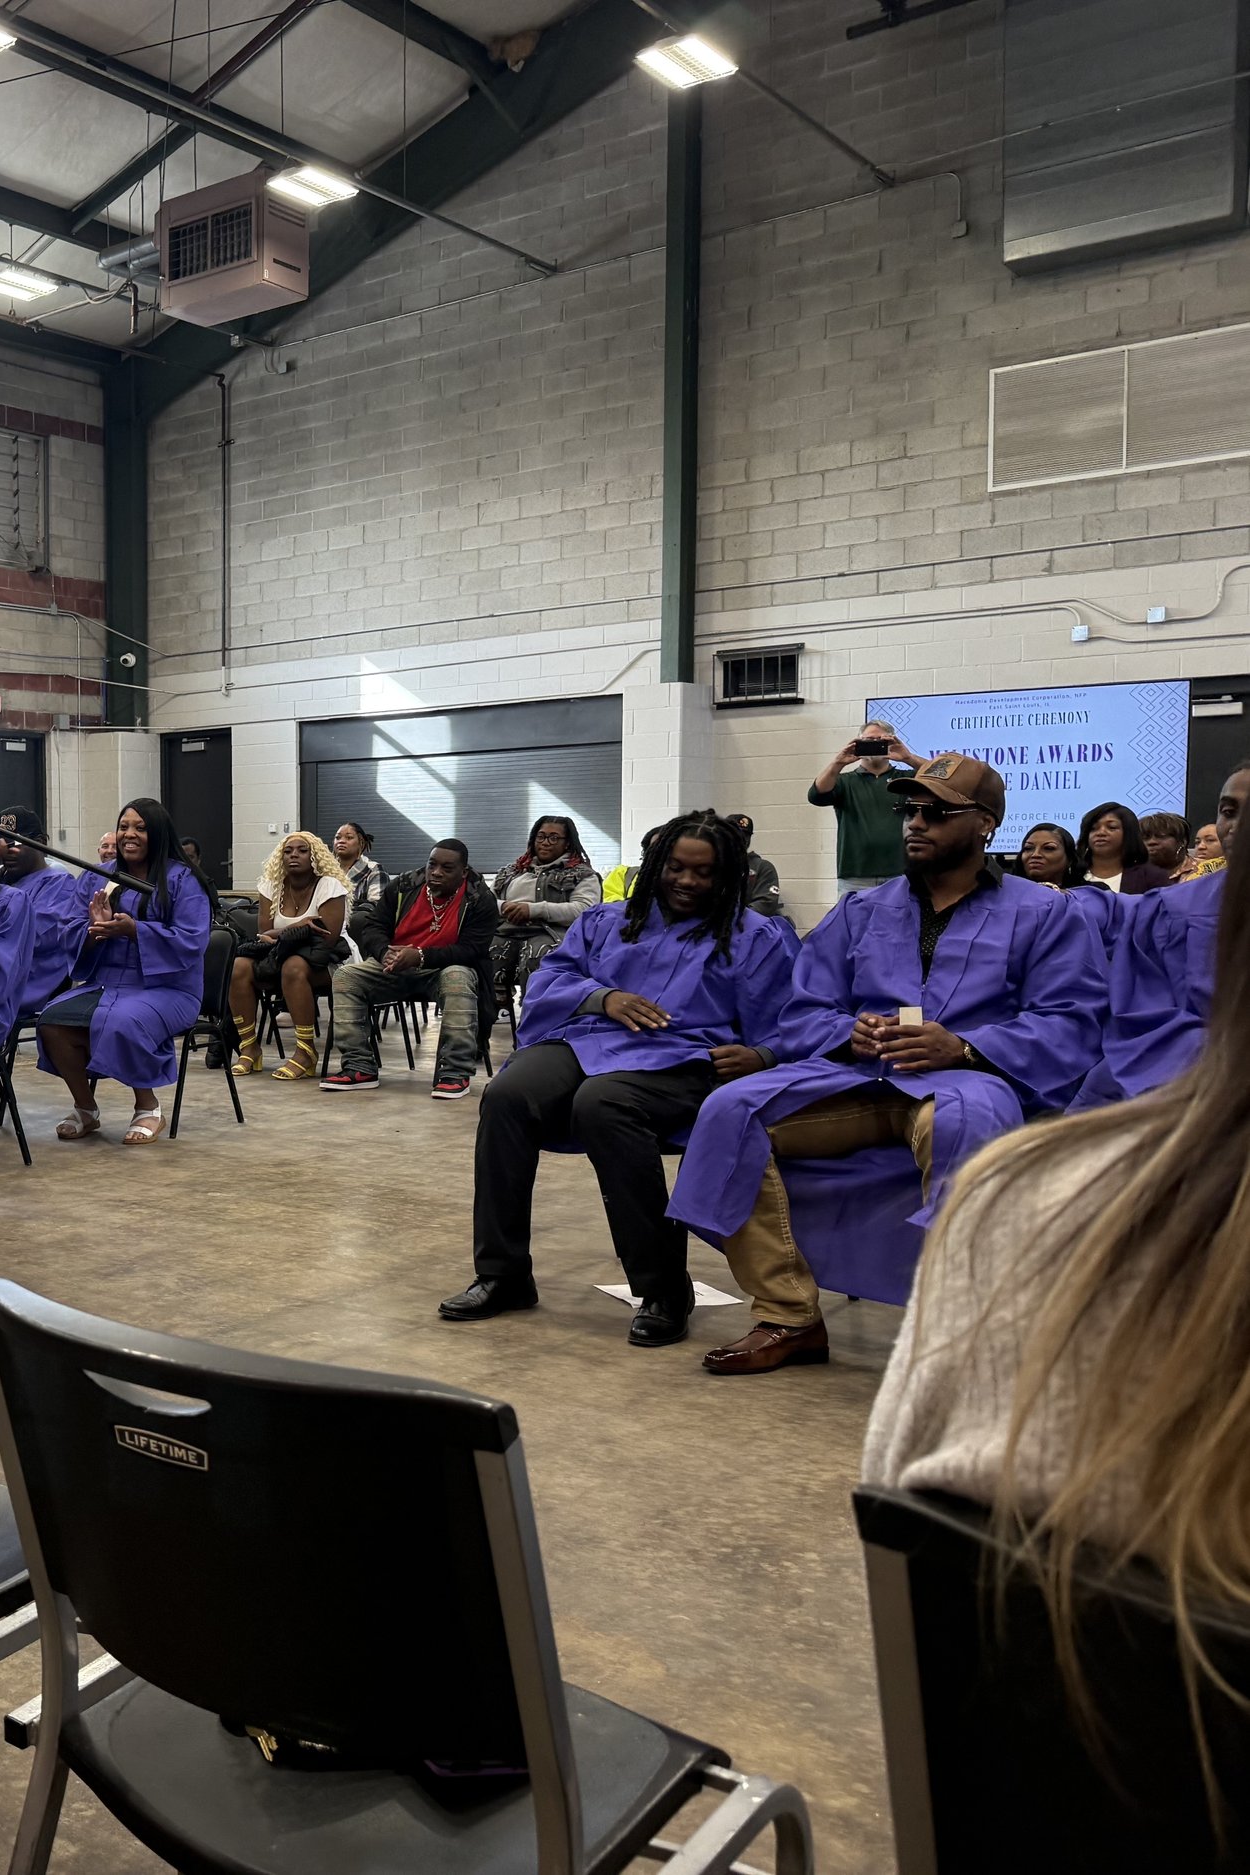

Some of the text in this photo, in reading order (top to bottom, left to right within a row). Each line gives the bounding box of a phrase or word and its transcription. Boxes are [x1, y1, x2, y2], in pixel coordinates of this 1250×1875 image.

[950, 710, 1091, 730] CERTIFICATE CEREMONY
[929, 742, 1113, 766] STONE AWARDS
[1020, 770, 1081, 791] DANIEL
[1053, 812, 1076, 820] HUB
[124, 1431, 198, 1464] LIFETIME
